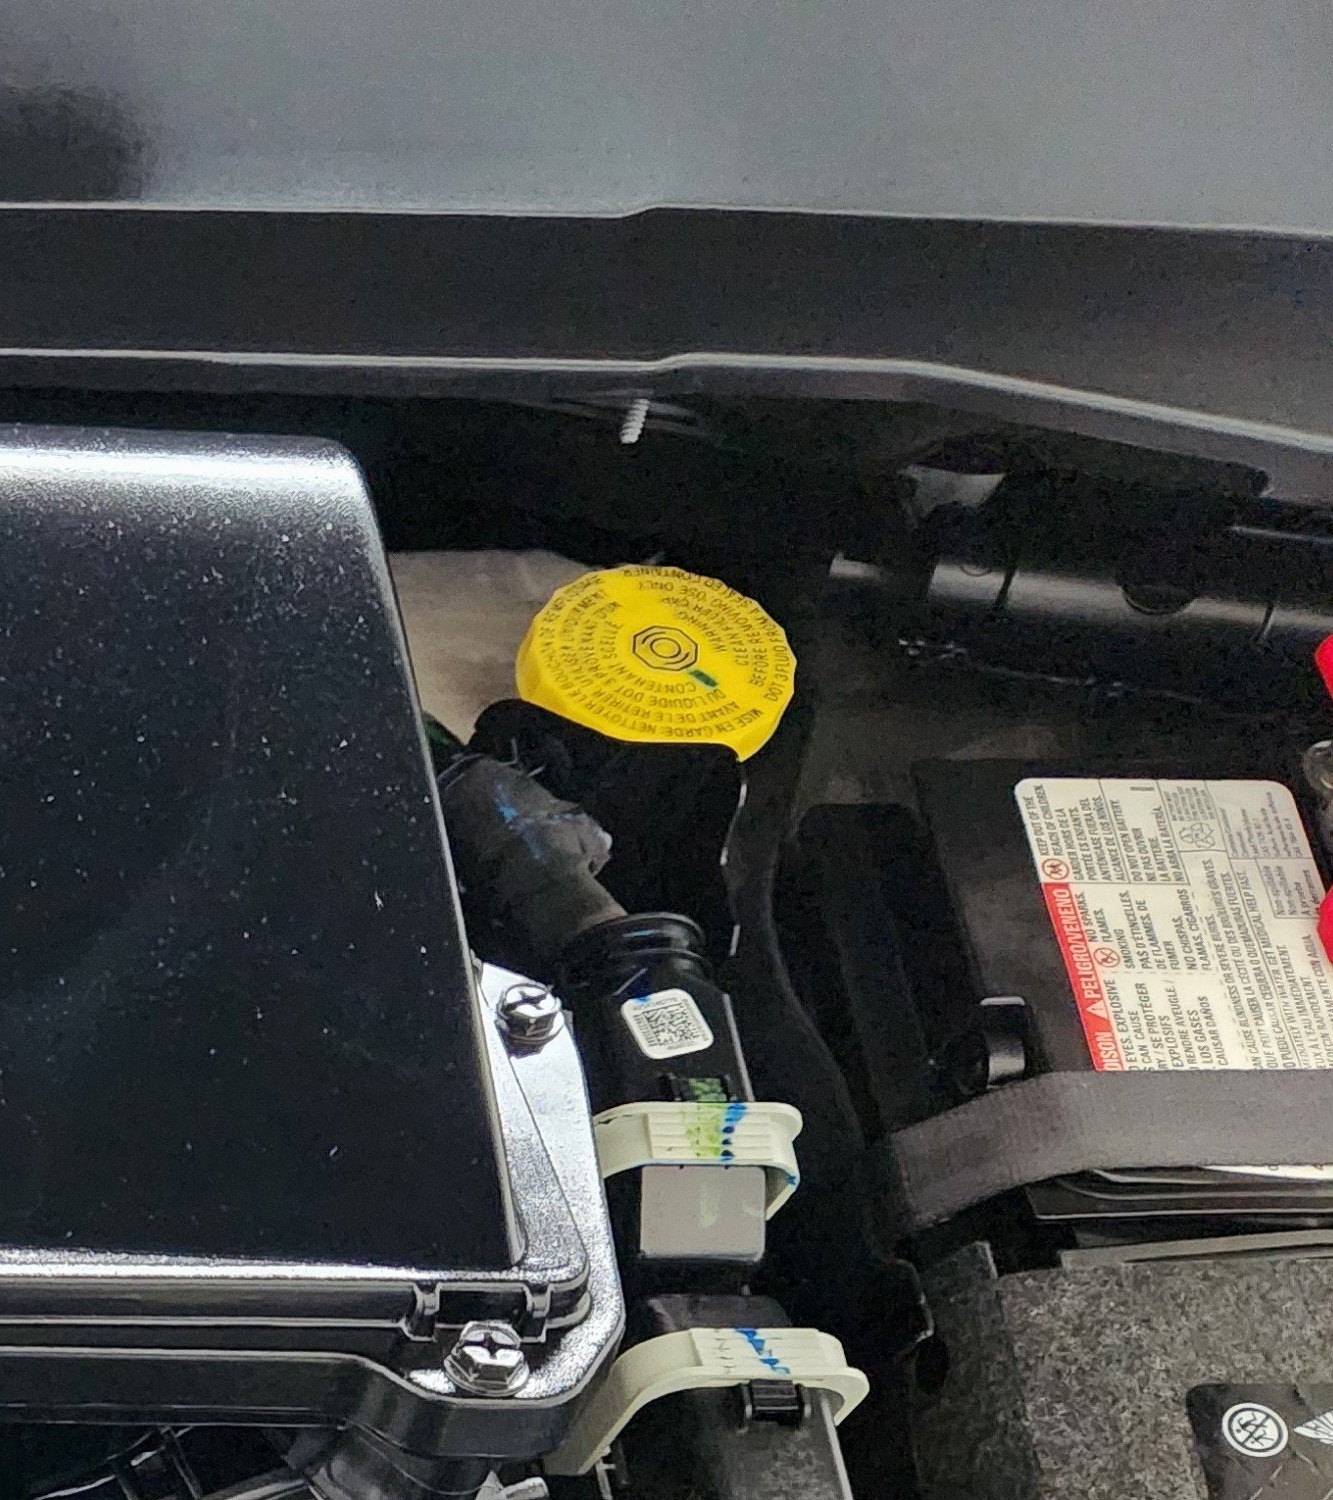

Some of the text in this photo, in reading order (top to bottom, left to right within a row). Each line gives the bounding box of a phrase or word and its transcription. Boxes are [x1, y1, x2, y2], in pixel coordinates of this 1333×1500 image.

[758, 615, 779, 643] FROM
[729, 632, 750, 666] CLEAN
[773, 645, 790, 673] FLUID
[749, 648, 769, 687] BEFORE
[612, 663, 696, 694] CONTENANT
[614, 684, 644, 701] DOT
[649, 695, 703, 709] LIQUIDE
[706, 689, 726, 704] DU
[763, 682, 783, 702] DOT
[585, 701, 657, 734] NETTOYER
[702, 701, 740, 722] AVANT
[734, 708, 763, 727] MISE
[716, 719, 734, 733] EN
[1079, 797, 1091, 811] DEL
[1023, 796, 1050, 856] KEEP OUT OF THE
[1044, 821, 1056, 831] OF
[1084, 812, 1099, 836] FUERA
[1099, 821, 1112, 835] LOS
[1048, 831, 1063, 856] REACH
[1054, 808, 1084, 880] GARDER HORS DE LA
[1104, 837, 1115, 848] DE
[1120, 833, 1134, 852] OPEN
[1162, 839, 1174, 849] LA
[1108, 848, 1125, 881] ALCANCE
[1126, 854, 1139, 870] NOT
[1131, 828, 1157, 881] NE PAS OUVRIR
[1166, 849, 1180, 870] ABRA
[1131, 871, 1143, 881] DO
[1159, 872, 1171, 881] LA
[1173, 871, 1183, 881] NO
[1135, 899, 1147, 911] DE
[1177, 889, 1199, 931] CIGARROS
[1244, 892, 1259, 912] HELP
[1084, 928, 1098, 942] NO
[1224, 930, 1238, 944] DES
[1231, 907, 1258, 958] QUEMADURAS
[1251, 914, 1272, 949] MEDICAL
[1114, 929, 1135, 969] SMOKING
[1137, 950, 1153, 969] PAS
[1163, 940, 1181, 970] FUMER
[1214, 943, 1231, 971] SEVERE
[1231, 946, 1243, 957] OU
[1264, 951, 1278, 966] GET
[1154, 958, 1167, 969] DE
[1184, 956, 1198, 970] NO
[1310, 960, 1324, 977] CON
[1052, 888, 1122, 1071] OISON PELIGRO/VENENO
[1223, 973, 1235, 983] OR
[1253, 966, 1274, 1000] CEGUERA
[1244, 986, 1255, 995] LA
[1104, 979, 1128, 1033] EXPLOSIVE
[1135, 983, 1159, 1034] PROTÉGER
[1227, 985, 1250, 1028] BLINDNESS
[1247, 997, 1265, 1026] CAUSER
[1282, 1001, 1296, 1023] WITH
[1128, 1010, 1145, 1040] CAUSE
[1265, 1001, 1284, 1034] CAUSAR
[1159, 1015, 1183, 1067] EXPLOSIFS
[1187, 1009, 1213, 1064] LOS GASES
[1198, 996, 1228, 1066] CAUSAR DAÑOS
[1242, 1029, 1259, 1053] CAUSE
[1257, 1028, 1273, 1048] PEUT
[1151, 1036, 1164, 1049] SE
[1178, 1029, 1197, 1064] RENDRE
[1275, 1036, 1293, 1060] PUEDE
[1138, 1045, 1151, 1064] CAN
[1252, 1056, 1264, 1070] AN
[1313, 1050, 1327, 1070] EUX
